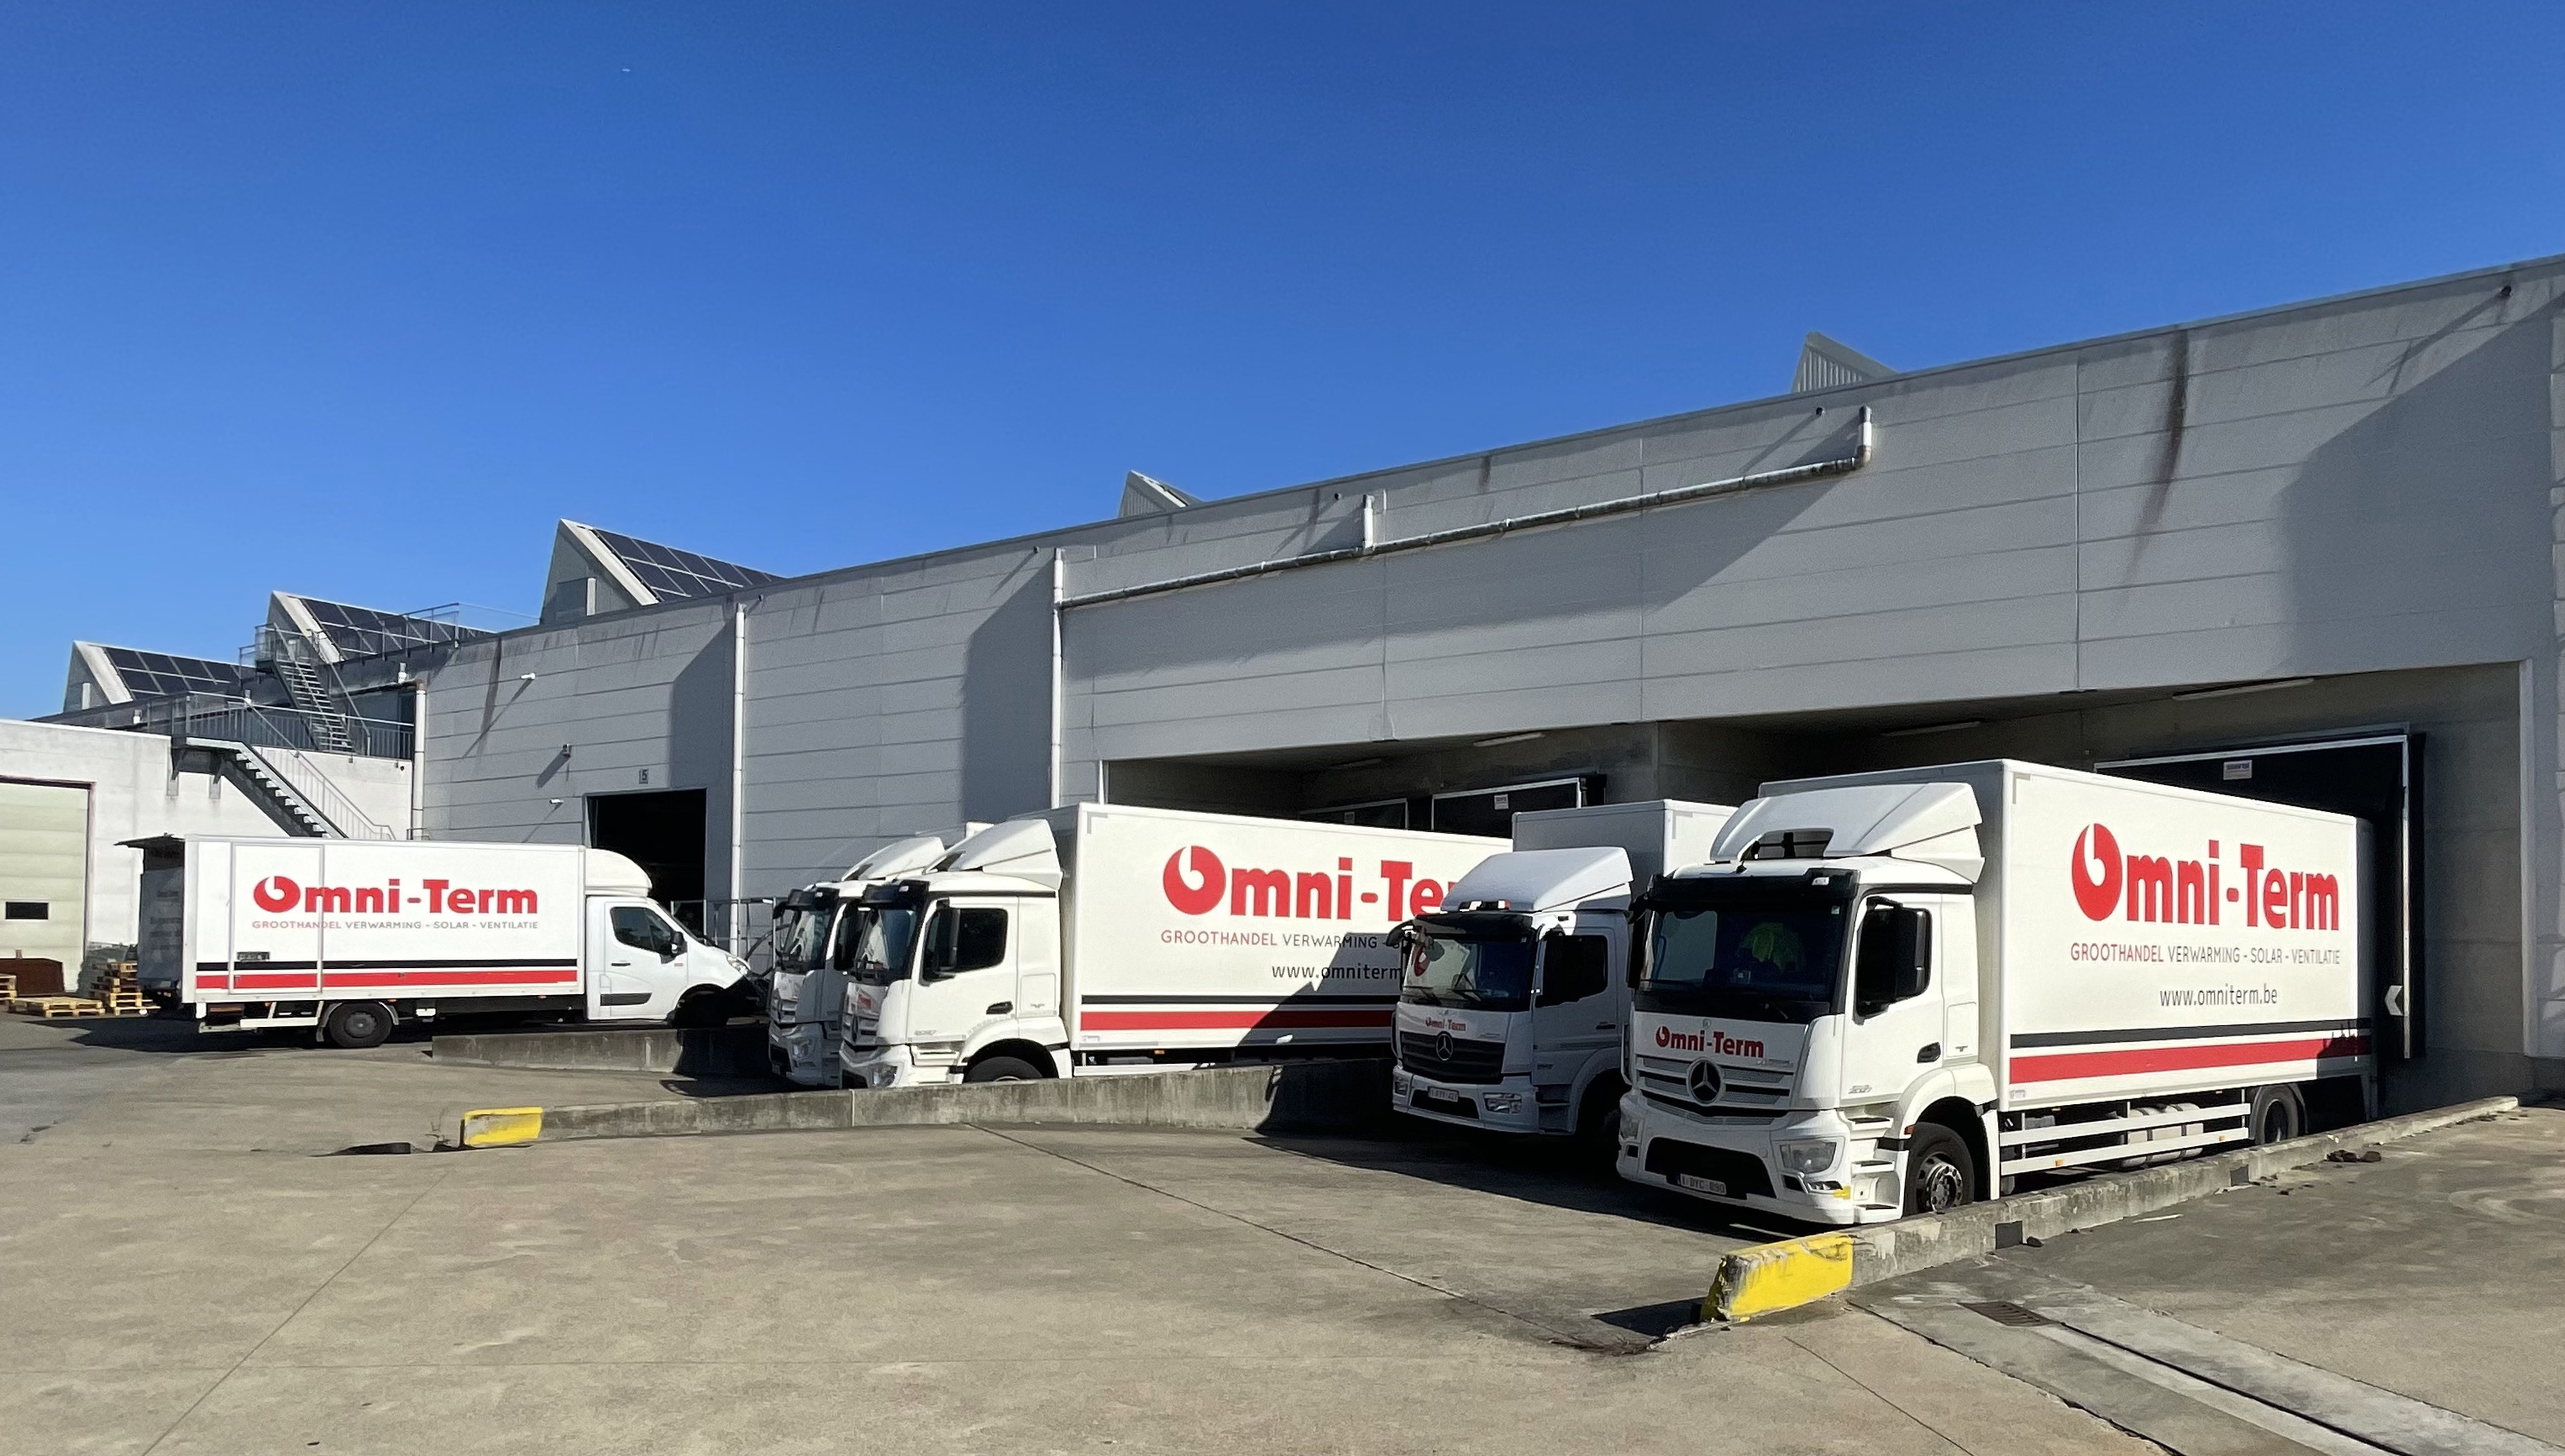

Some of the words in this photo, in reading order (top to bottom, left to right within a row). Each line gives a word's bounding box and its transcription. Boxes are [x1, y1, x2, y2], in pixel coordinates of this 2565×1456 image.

[1163, 845, 1457, 922] Omni-Te
[2072, 824, 2339, 930] Omni-Term
[254, 876, 538, 914] Omni-Term
[252, 920, 342, 929] GROOTHANDEL
[480, 921, 538, 930] VENTILATIE
[1162, 930, 1277, 946] GROOTHANDEL
[1282, 933, 1377, 949] VERWARMING
[2070, 942, 2164, 962] GROOTHANDEL
[2168, 945, 2240, 963] VERWARMING
[2250, 947, 2282, 963] SOLAR
[2291, 949, 2340, 964] VENTILATIE
[2159, 982, 2278, 1006] www.omniterm.be
[1425, 1017, 1466, 1032] Omni-Term
[1655, 1026, 1765, 1058] Omni-Term
